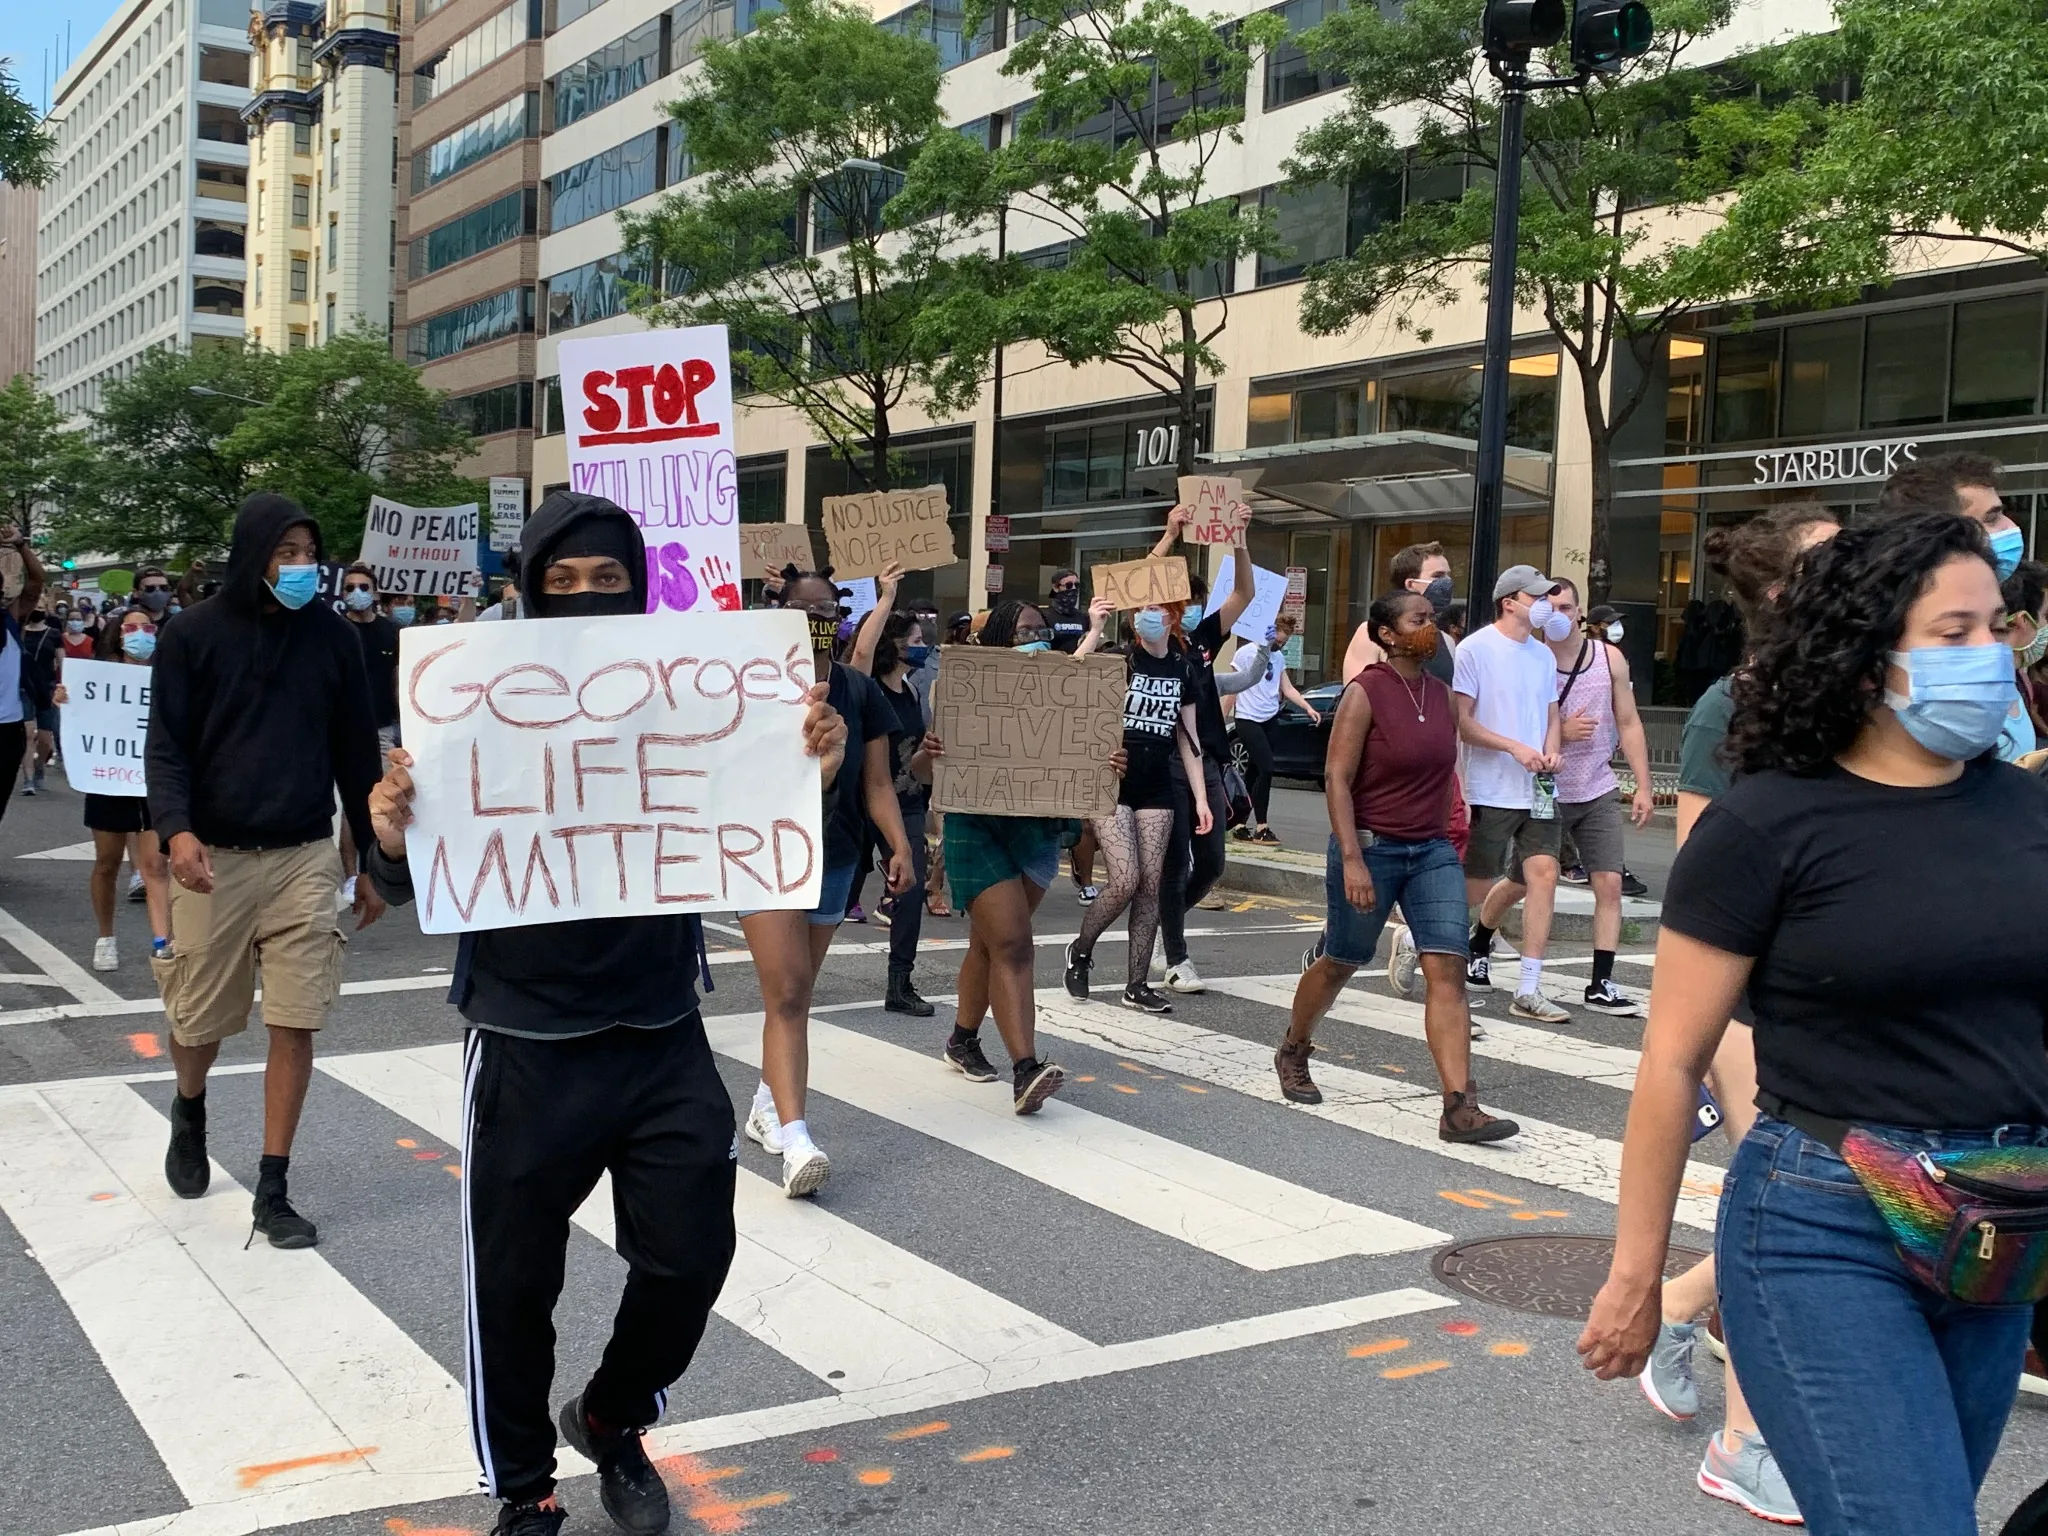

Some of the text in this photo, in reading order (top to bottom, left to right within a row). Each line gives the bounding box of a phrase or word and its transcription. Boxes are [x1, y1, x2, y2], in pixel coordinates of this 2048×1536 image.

[582, 359, 716, 432] STOP
[1136, 424, 1200, 467] 101
[1753, 442, 1918, 485] STARBUCKS
[497, 503, 517, 511] FOR
[1199, 480, 1226, 505] AM
[370, 505, 478, 542] NO PEACE
[491, 512, 522, 520] LEASE
[831, 495, 942, 533] NO JUSTICE
[1209, 506, 1222, 524] I
[388, 545, 461, 562] WITHOUT
[739, 527, 783, 545] STOP
[752, 544, 808, 562] KILLING
[833, 532, 940, 570] NO PEACE
[1195, 523, 1245, 548] NEXT
[1104, 561, 1189, 606] ACAB
[409, 639, 813, 743] George's
[946, 659, 1124, 709] BLACK
[1131, 676, 1181, 696] BLACK
[1124, 692, 1181, 721] LIVES
[943, 705, 1119, 761] LIVES
[470, 733, 710, 817] LIFE
[940, 765, 1118, 812] MATTER
